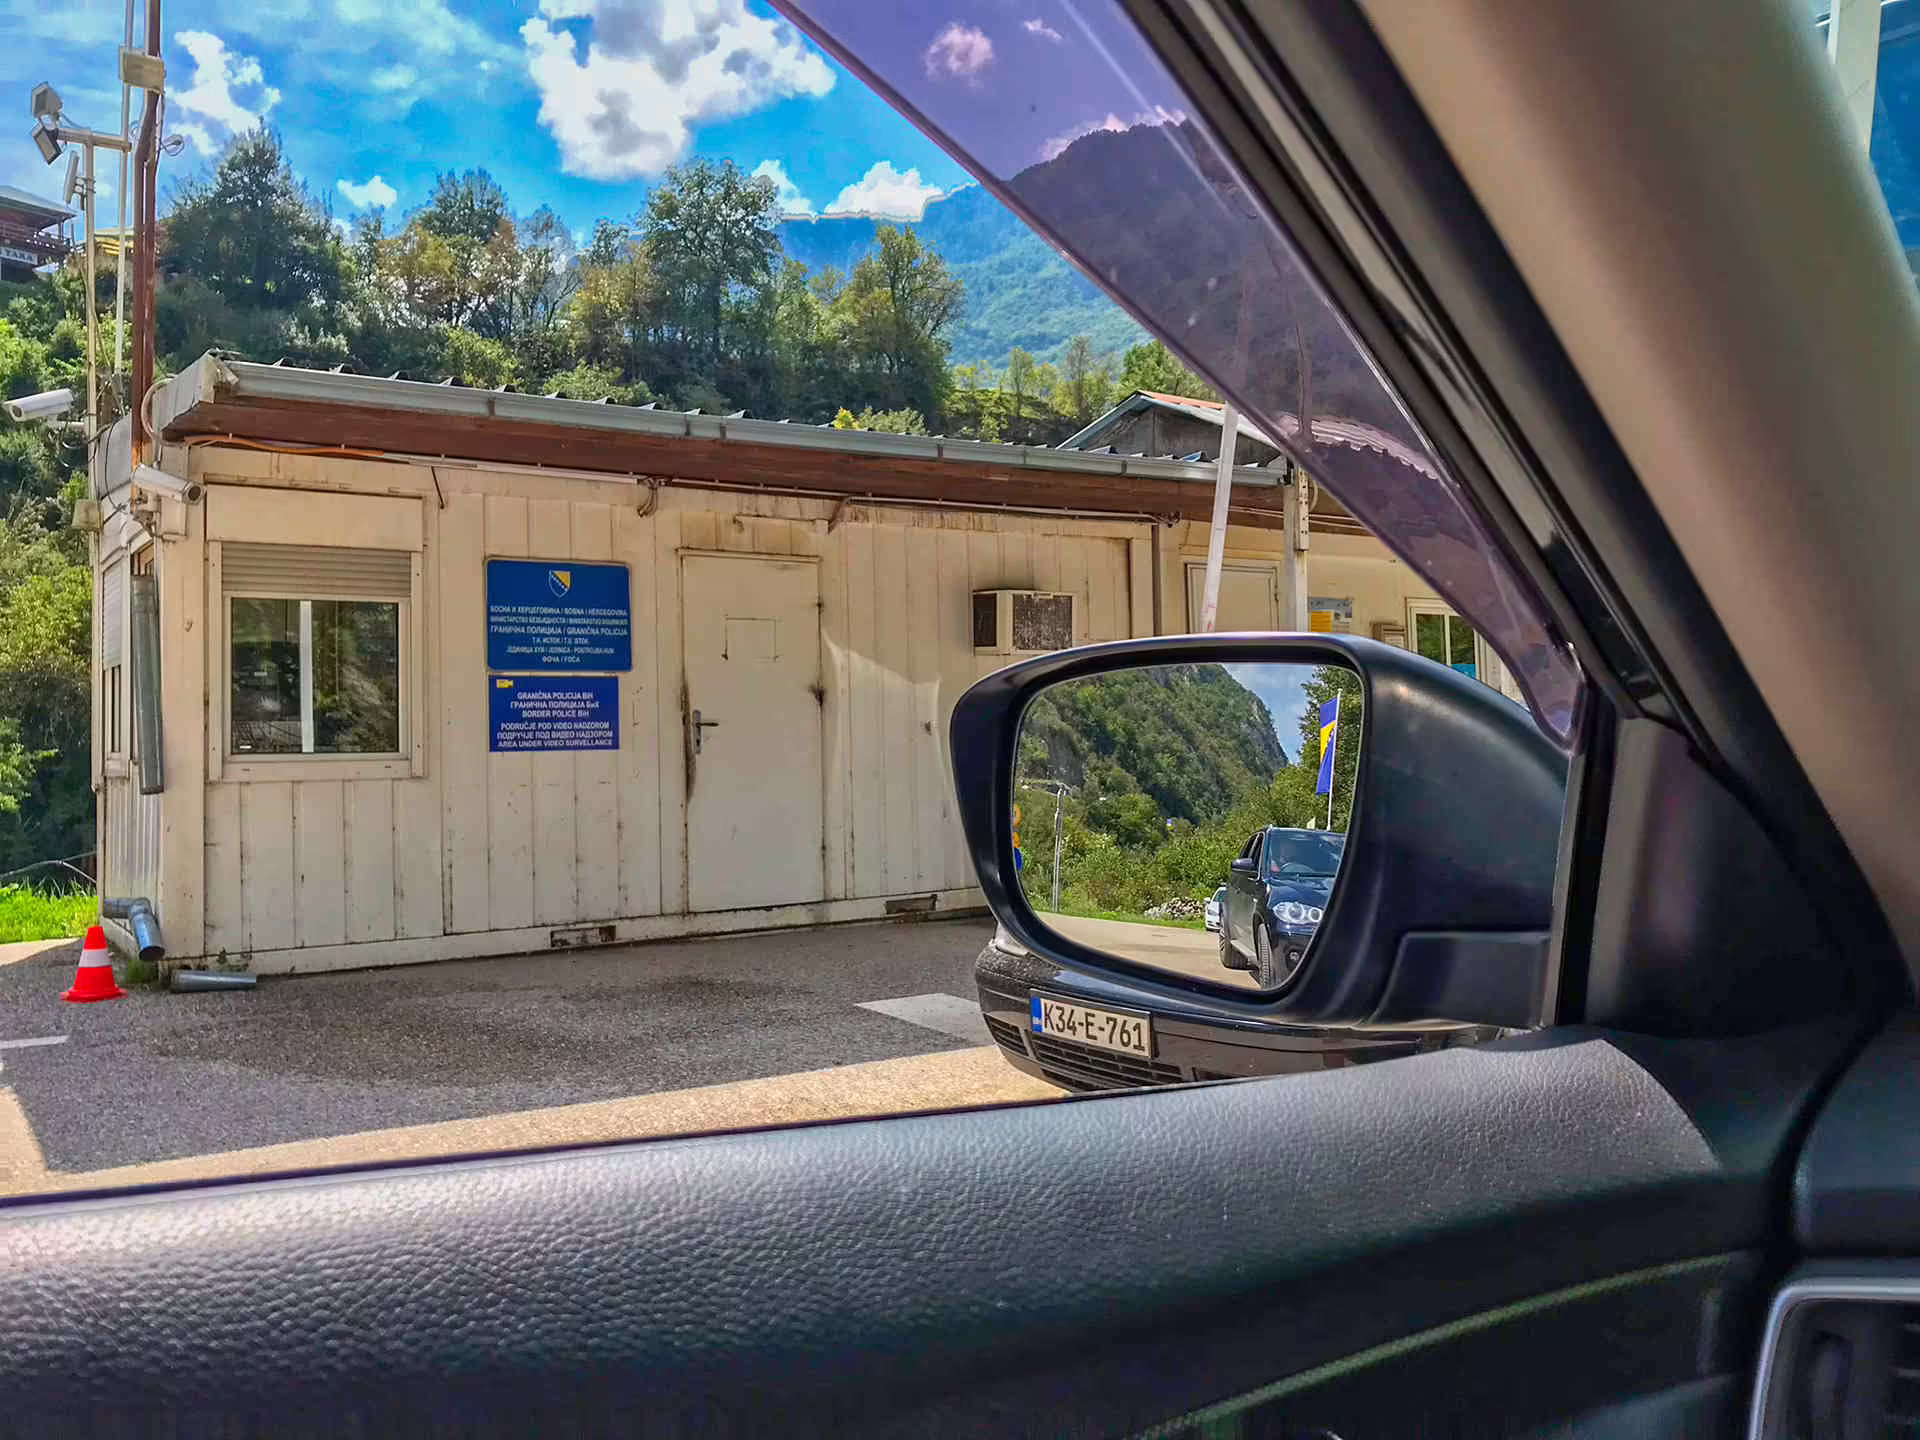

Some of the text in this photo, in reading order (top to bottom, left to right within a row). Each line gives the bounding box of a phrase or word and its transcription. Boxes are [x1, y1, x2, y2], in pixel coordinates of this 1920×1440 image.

[517, 690, 552, 700] GRANIČNA
[553, 691, 581, 700] POLICIJA
[510, 701, 547, 709] ГРАНИЧНА
[549, 701, 585, 710] ПОЛИЦИЈА
[522, 710, 551, 718] BORDER
[552, 710, 576, 718] POLICE
[500, 721, 609, 731] PODRUČJE POD VIDEO NADZOROM
[497, 730, 613, 741] ПОДРУЧЈЕ ПОД ВИДЕО НАДЗОРОМ
[518, 739, 543, 747] UNDER
[543, 739, 565, 747] VIDEO
[1043, 1002, 1145, 1052] K34-E-761
